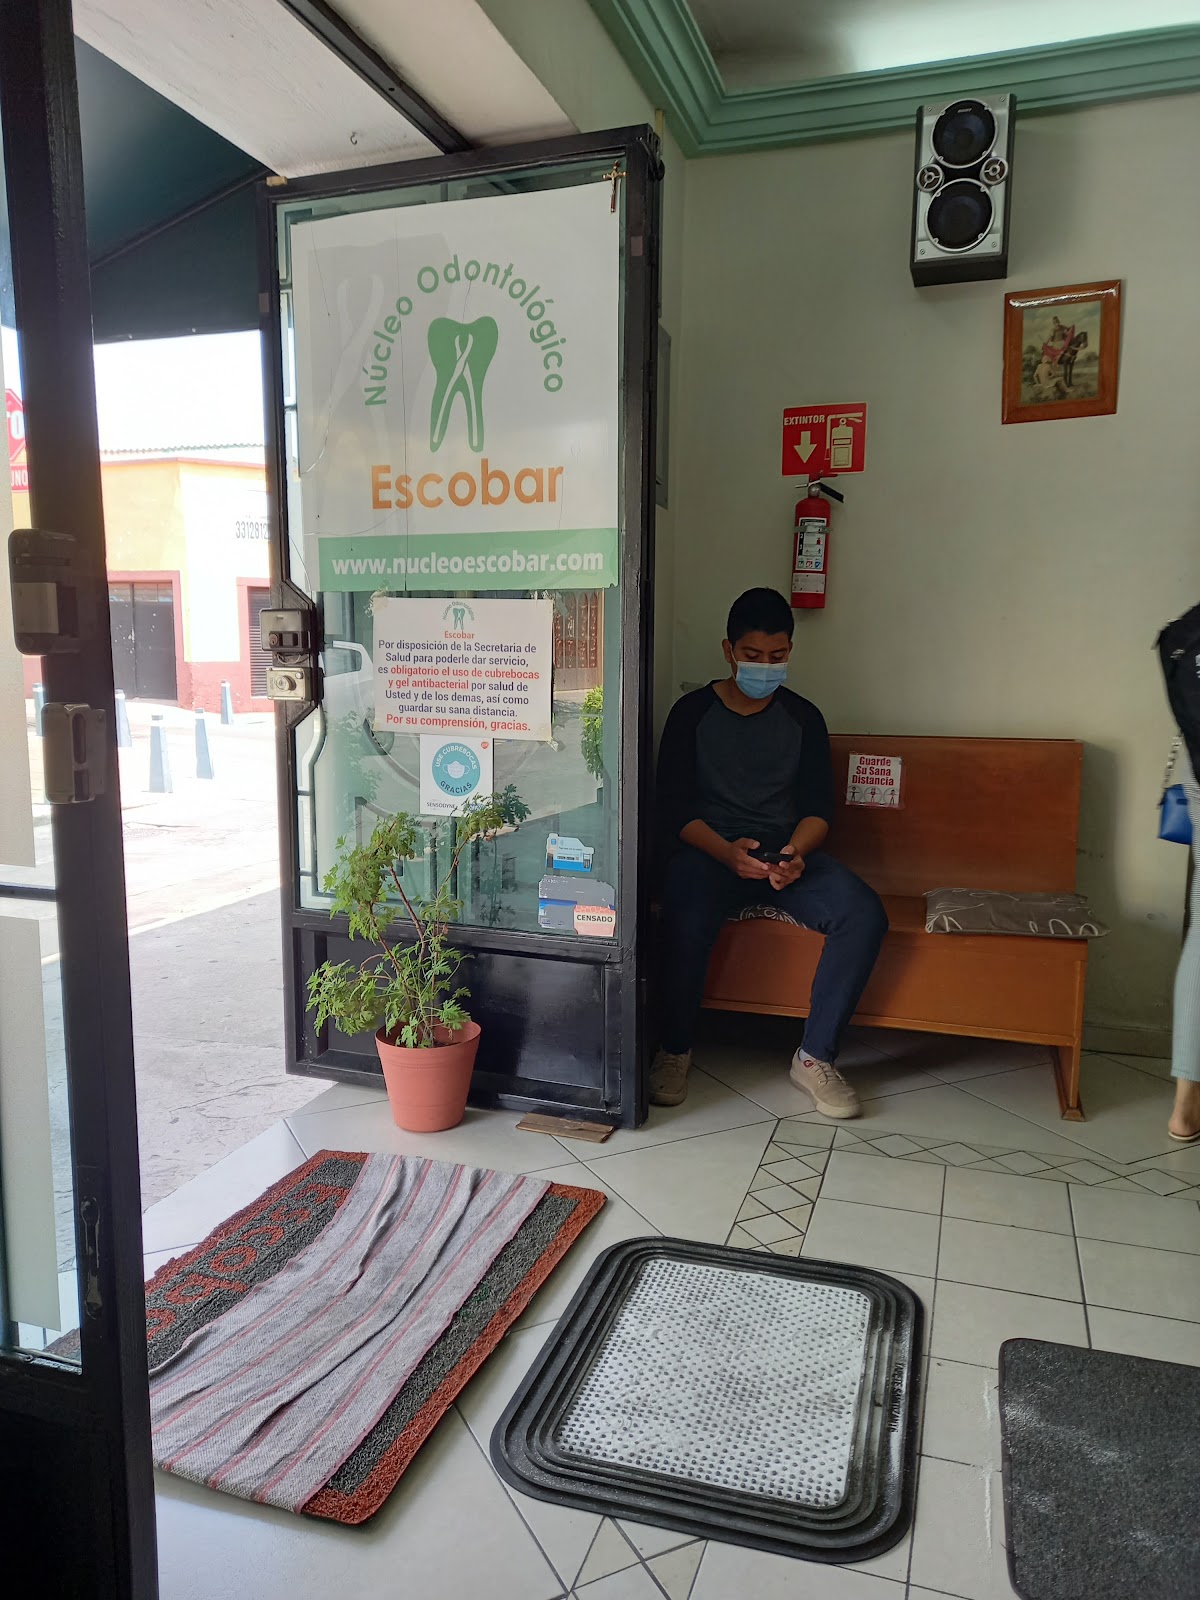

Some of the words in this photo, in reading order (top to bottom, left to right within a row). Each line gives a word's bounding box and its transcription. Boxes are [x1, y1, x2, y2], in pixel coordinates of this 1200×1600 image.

[362, 296, 413, 406] Núcleo
[417, 254, 567, 392] Odontológico
[783, 414, 826, 426] EXTINTOR
[371, 458, 564, 510] Escobar
[332, 550, 604, 575] www.nucleoescobar.com
[444, 630, 475, 639] Escobar
[378, 640, 394, 649] Por
[397, 640, 448, 652] disposición
[451, 641, 462, 651] de
[463, 642, 472, 651] la
[474, 642, 522, 653] Secretaria
[524, 643, 537, 653] de
[385, 653, 411, 662] Salud
[413, 655, 433, 664] para
[435, 655, 470, 665] poderle
[472, 655, 486, 664] dar
[488, 656, 529, 667] servicio,
[390, 665, 440, 677] obligatorio
[442, 666, 450, 676] el
[452, 669, 469, 677] uso
[471, 668, 483, 677] de
[484, 668, 540, 680] cubrebocas
[388, 680, 393, 688] y
[395, 678, 409, 688] gel
[411, 678, 469, 690] antibacterial
[471, 682, 486, 692] por
[488, 682, 514, 692] salud
[516, 682, 529, 692] de
[385, 690, 411, 699] Usted
[413, 692, 419, 701] y
[421, 690, 433, 700] de
[435, 691, 449, 701] los
[451, 692, 484, 704] demas,
[486, 693, 501, 704] así
[502, 696, 529, 705] como
[398, 703, 433, 714] guardar
[435, 706, 447, 714] su
[449, 706, 471, 715] sana
[473, 705, 518, 717] distancia.
[386, 714, 403, 724] Por
[406, 716, 418, 725] su
[420, 717, 488, 730] comprensión,
[490, 719, 531, 732] gracias.
[435, 753, 444, 768] USE
[442, 745, 478, 770] CUBREBOCAS
[859, 756, 891, 766] Guarde
[856, 766, 867, 775] Su
[869, 766, 891, 776] Sana
[440, 780, 473, 794] GRACIAS
[851, 775, 894, 786] Distancia
[576, 914, 613, 923] CENSADO
